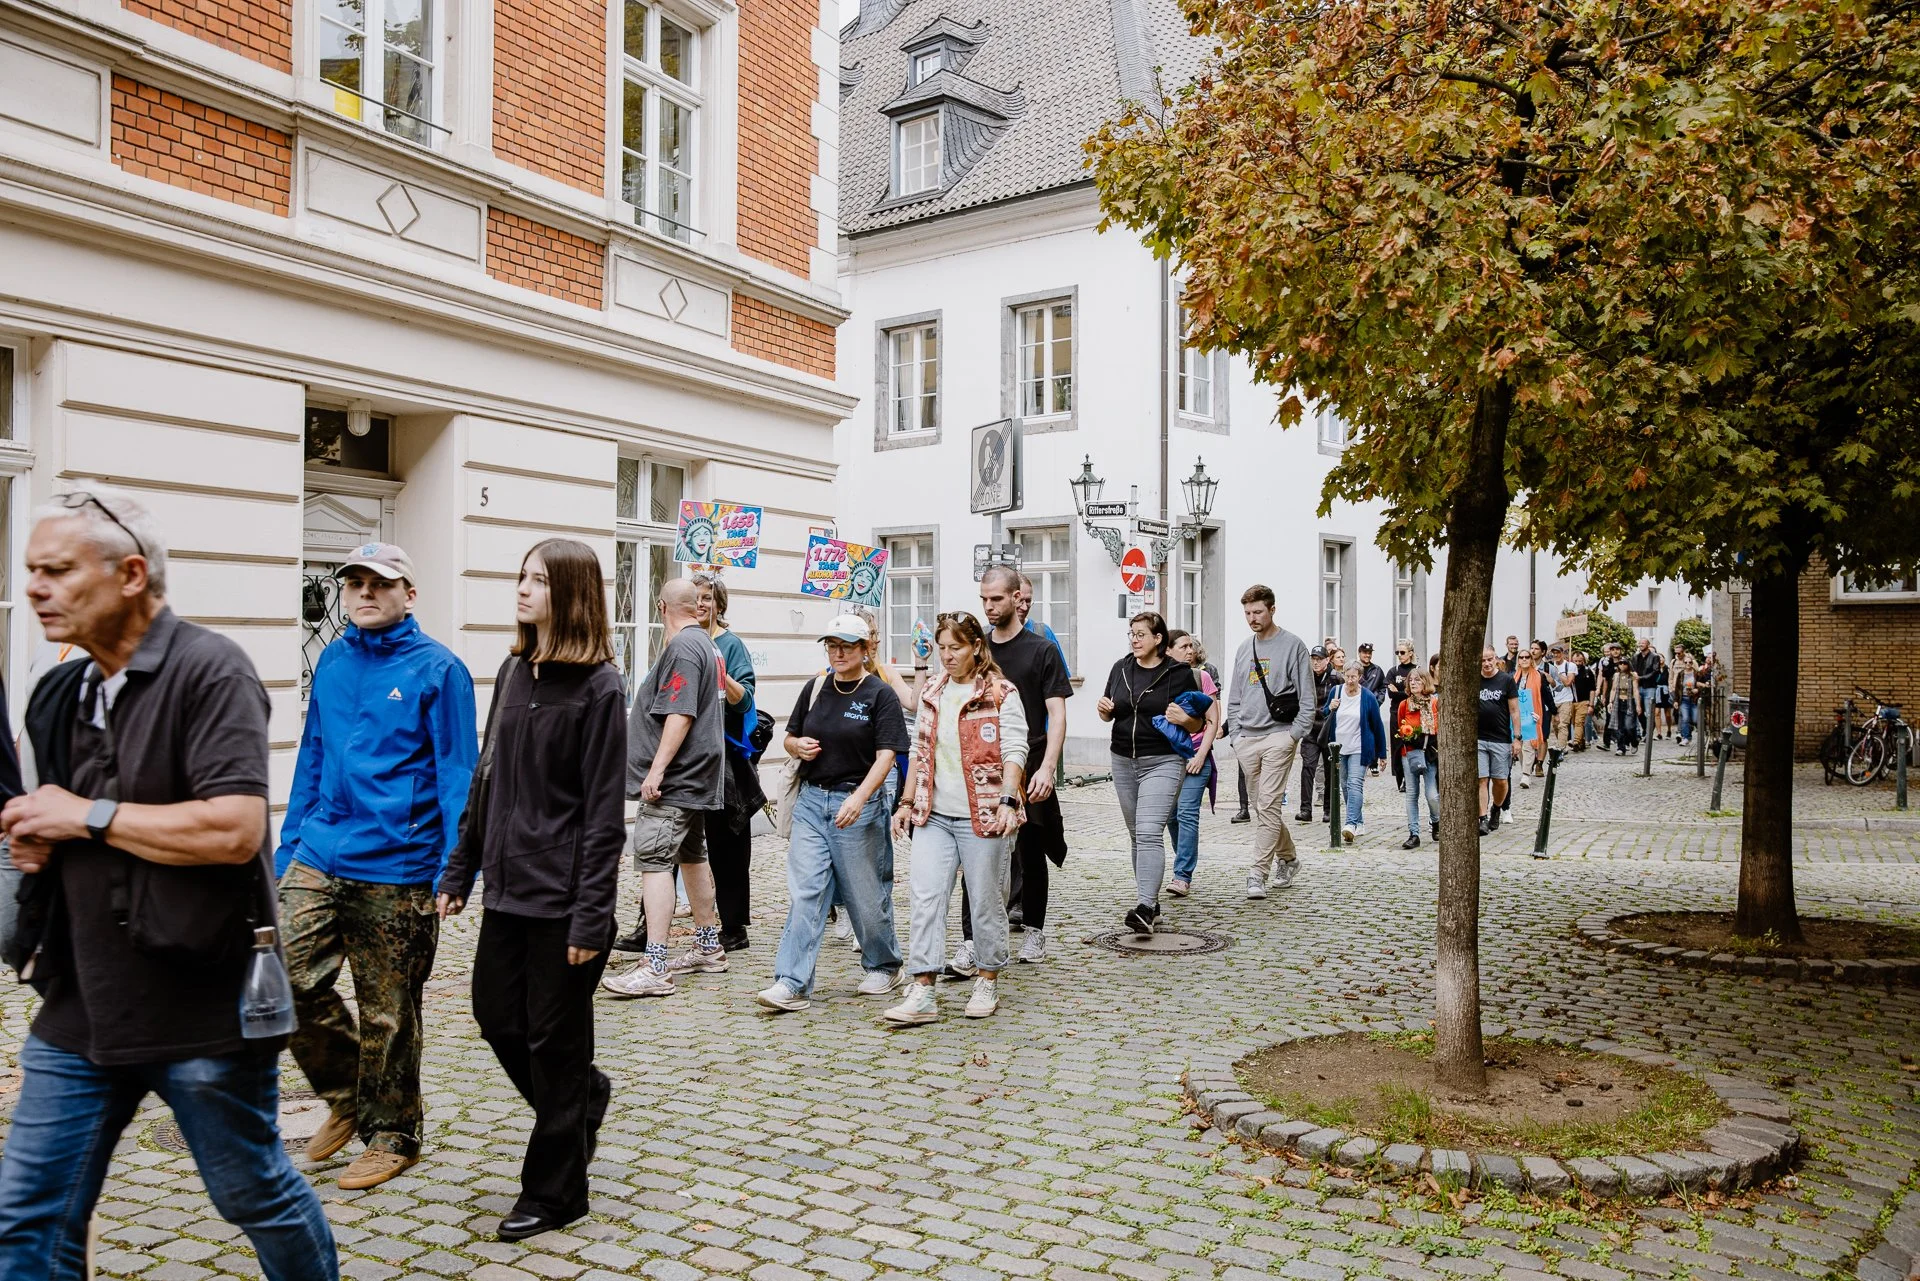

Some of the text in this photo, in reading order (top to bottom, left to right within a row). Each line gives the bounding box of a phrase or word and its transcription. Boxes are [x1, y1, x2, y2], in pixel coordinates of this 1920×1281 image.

[480, 486, 489, 507] 5
[1088, 503, 1124, 515] Ritterstraße
[722, 513, 755, 530] 1.658
[727, 528, 748, 539] TAGE
[814, 547, 847, 562] 1.776
[818, 561, 840, 571] TAGE
